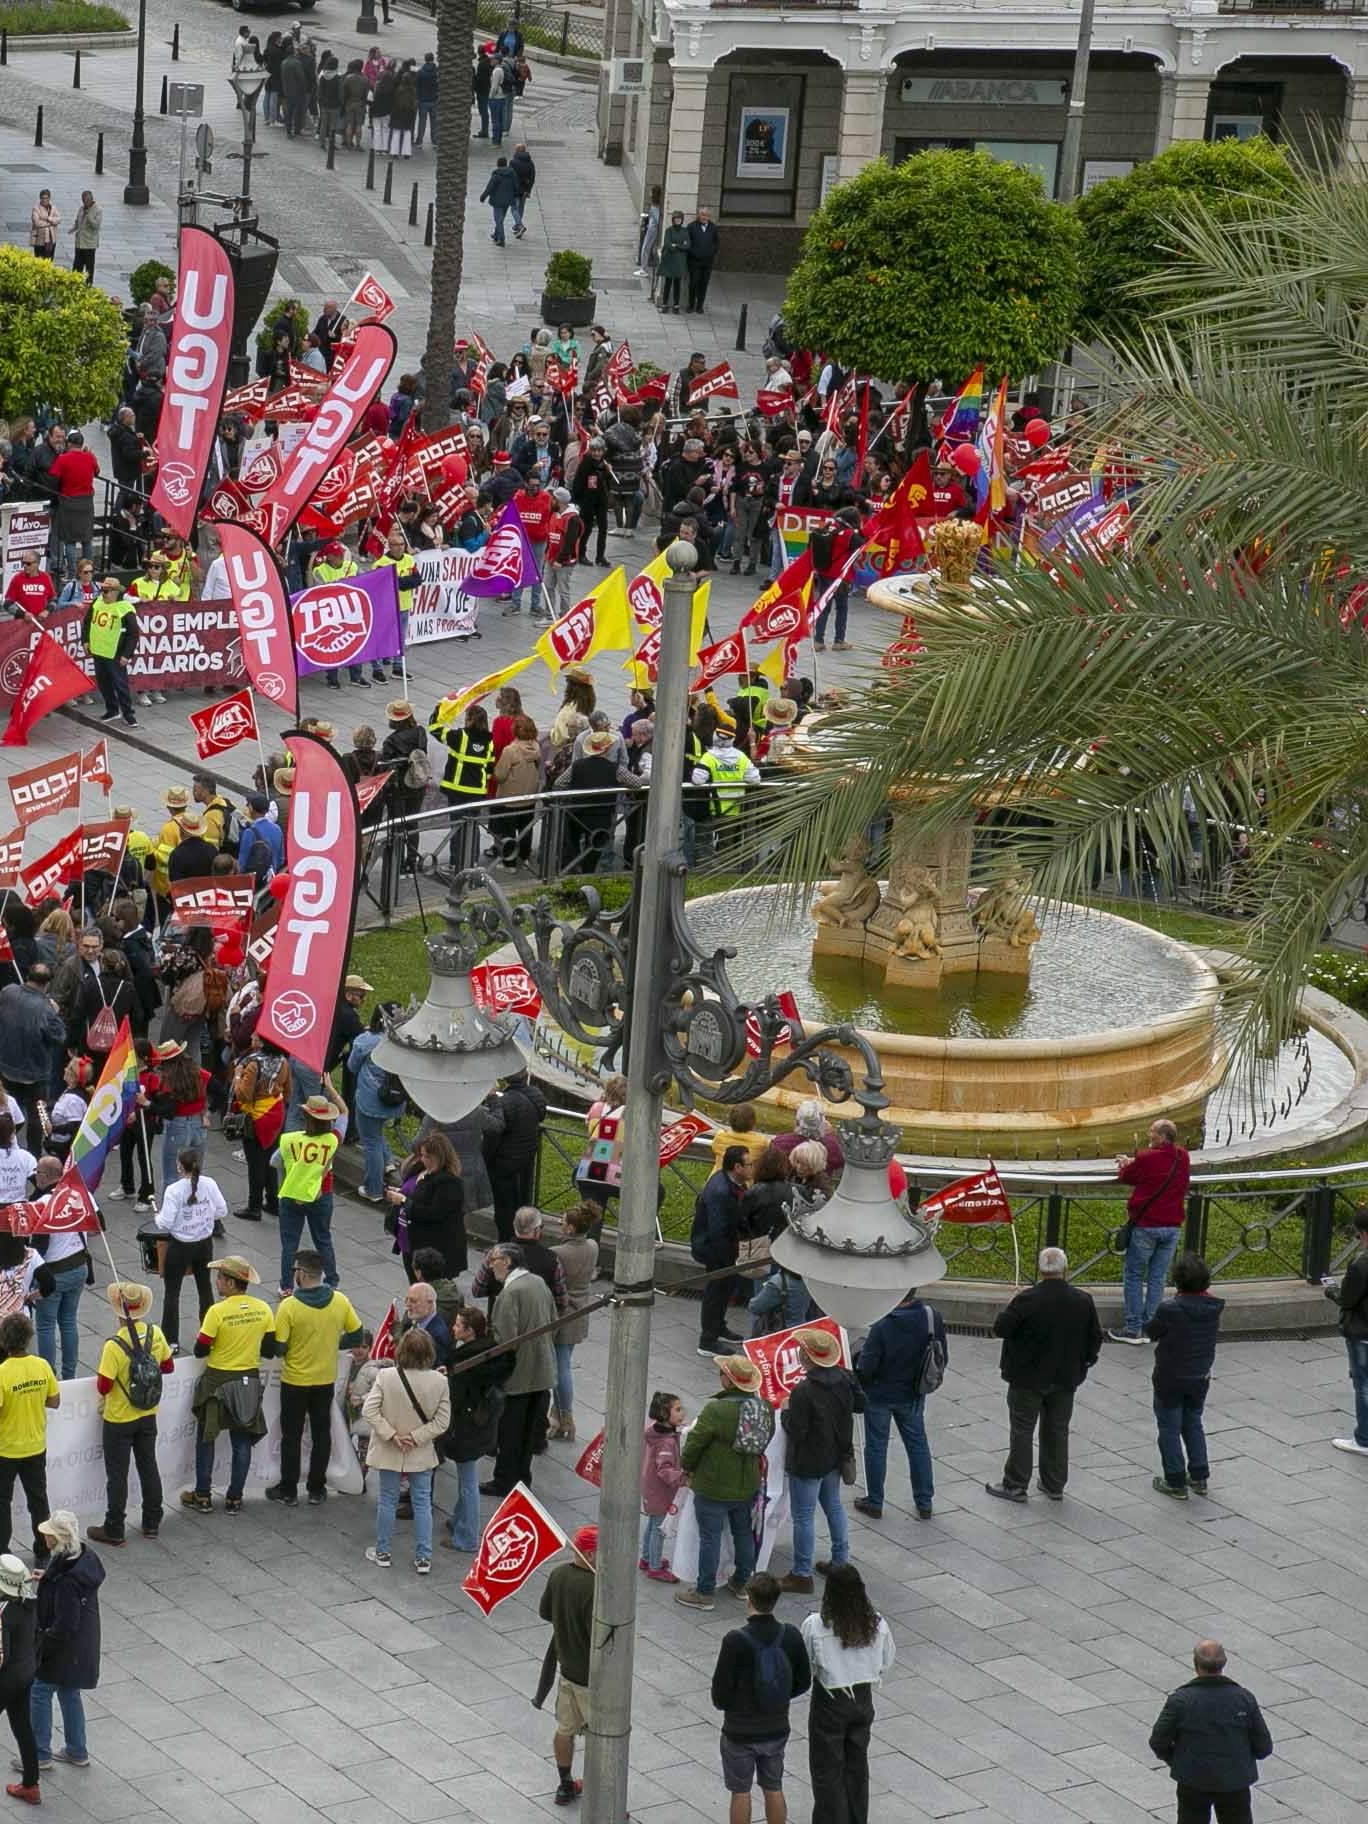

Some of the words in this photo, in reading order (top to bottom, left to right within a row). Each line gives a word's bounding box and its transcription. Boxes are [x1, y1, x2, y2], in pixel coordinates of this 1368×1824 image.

[22, 584, 40, 593] UGT
[173, 611, 240, 633] EMPLE
[212, 705, 242, 732] UGT
[494, 974, 529, 990] UGT
[289, 1142, 330, 1166] UGT
[486, 1519, 530, 1565] UGT
